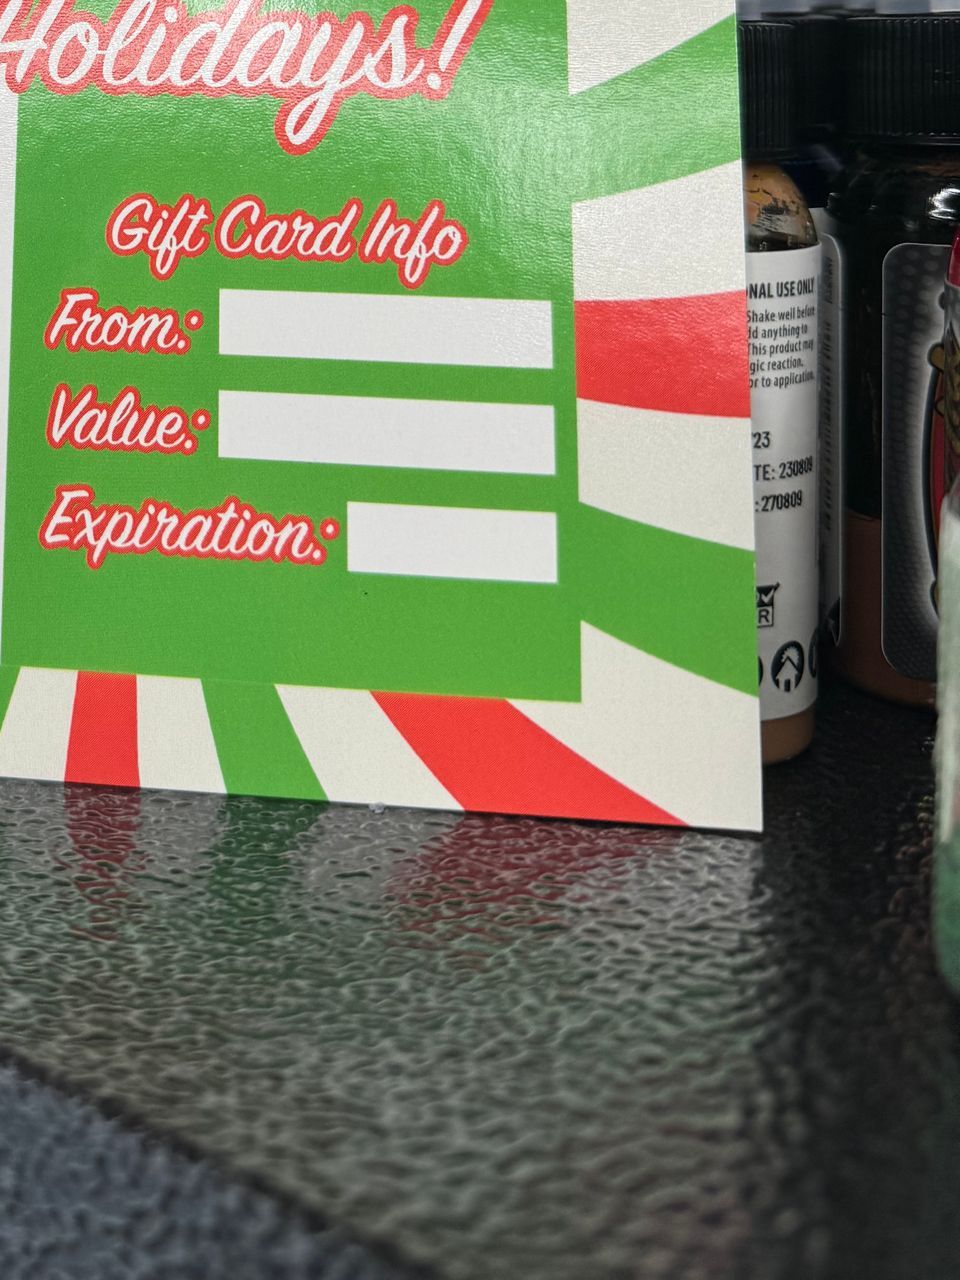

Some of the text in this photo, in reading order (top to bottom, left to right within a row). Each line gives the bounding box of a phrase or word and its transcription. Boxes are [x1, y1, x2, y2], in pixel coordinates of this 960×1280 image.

[108, 194, 468, 288] Gift Card Info
[746, 277, 814, 299] NAL USE ONLY
[45, 288, 206, 355] From:
[778, 307, 795, 321] well
[797, 304, 815, 318] before
[769, 340, 801, 357] product
[802, 339, 814, 352] may
[767, 356, 804, 371] reaction.
[762, 376, 771, 388] to
[46, 383, 210, 454] Value:
[752, 431, 771, 449] 23
[779, 456, 813, 479] 230809
[40, 485, 340, 569] Expiration:
